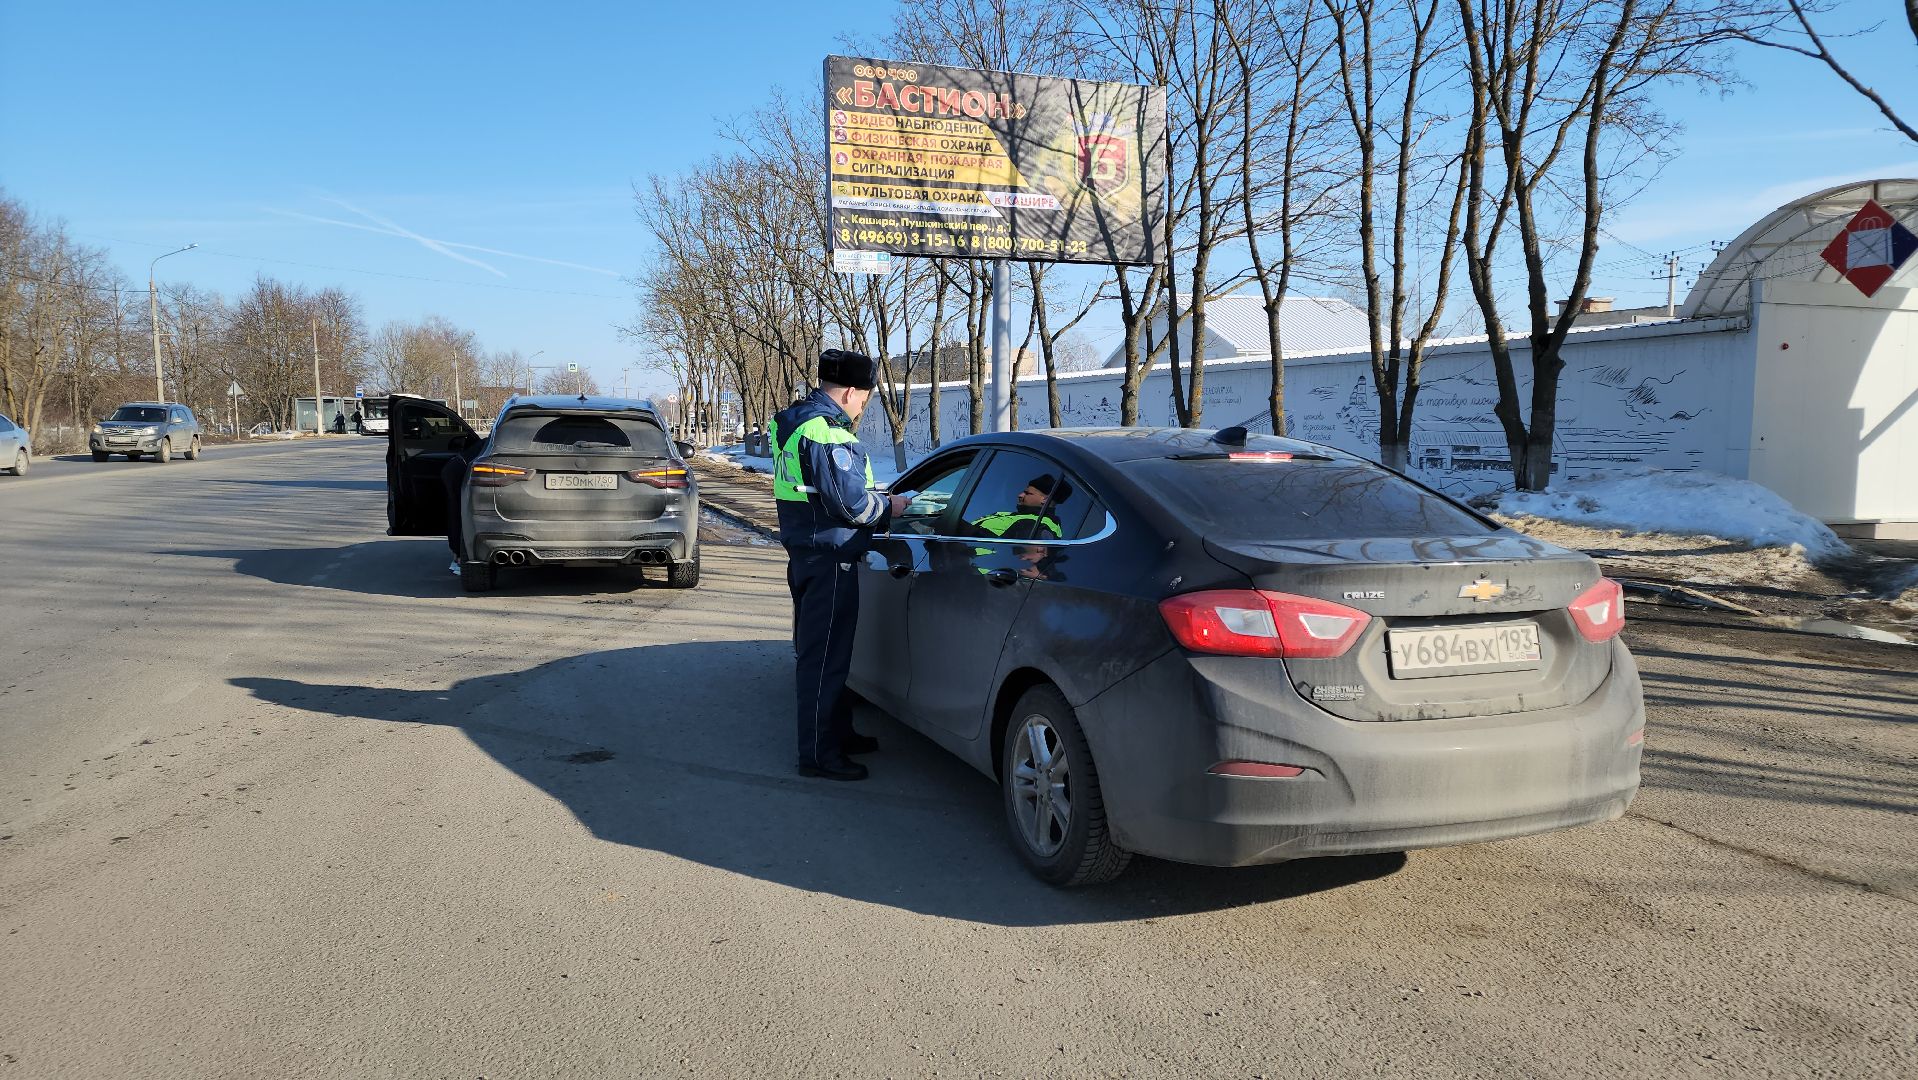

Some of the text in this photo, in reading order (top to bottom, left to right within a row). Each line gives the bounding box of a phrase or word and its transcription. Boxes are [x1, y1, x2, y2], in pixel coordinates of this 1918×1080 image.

[854, 65, 886, 79] ООО
[836, 80, 1027, 120] «БАСТИОН»
[850, 114, 984, 135] ВИДЕОНАБЛЮДЕНИЕ
[851, 131, 992, 152] ФИЗИЧЕСКАЯ ОХРАНА
[852, 149, 1003, 169] ОХРАННАЯ, ПОЖАРНАЯ
[852, 162, 955, 180] СИГНАЛИЗАЦИЯ
[852, 186, 984, 204] ПУЛЬТОВАЯ ОХРАНА
[1004, 193, 1055, 208] КАШИРЕ
[851, 214, 899, 227] Кашира,
[901, 218, 967, 230] Пушкинский
[841, 229, 1087, 253] 8 (49669) 3-15-16 8 (800) 700-51-23
[1343, 591, 1385, 600] CRUZE
[1400, 628, 1533, 666] У684ВХ 193
[1509, 651, 1526, 660] RUS
